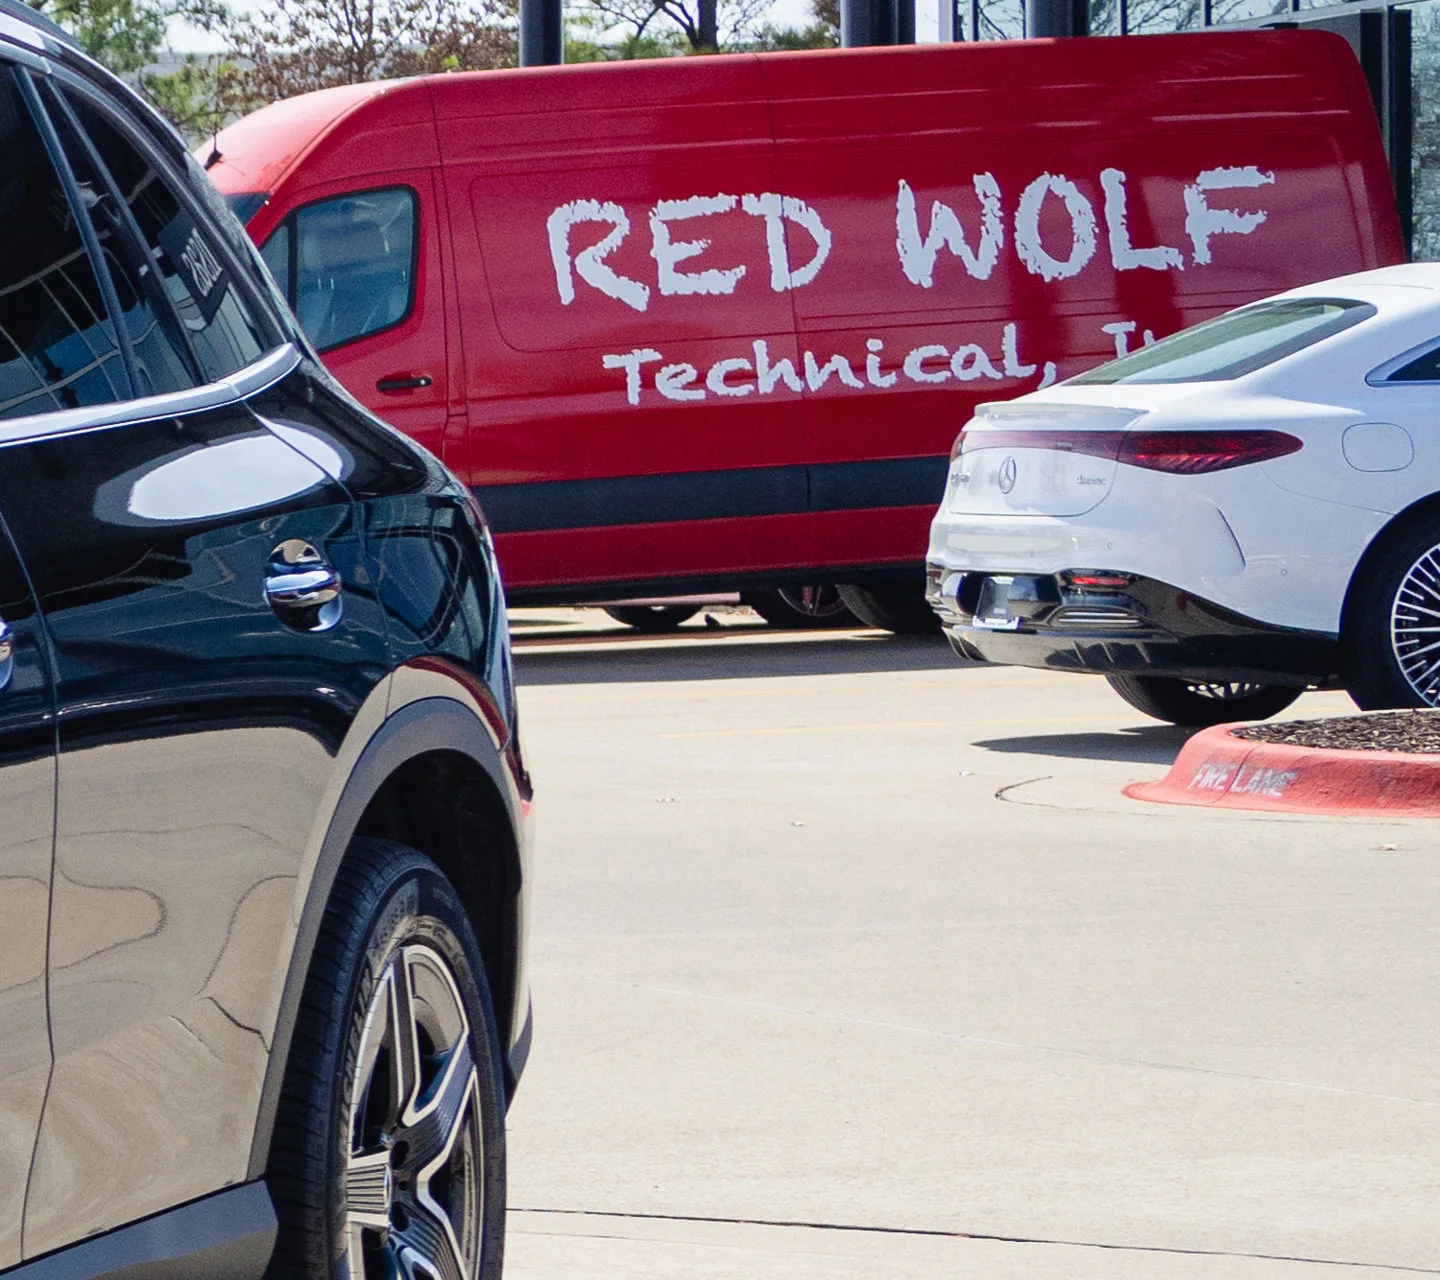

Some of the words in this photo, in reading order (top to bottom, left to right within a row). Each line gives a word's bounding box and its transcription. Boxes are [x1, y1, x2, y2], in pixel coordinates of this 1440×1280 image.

[546, 191, 833, 312] RED
[896, 166, 1276, 288] WOLF
[602, 322, 1057, 405] Technical,
